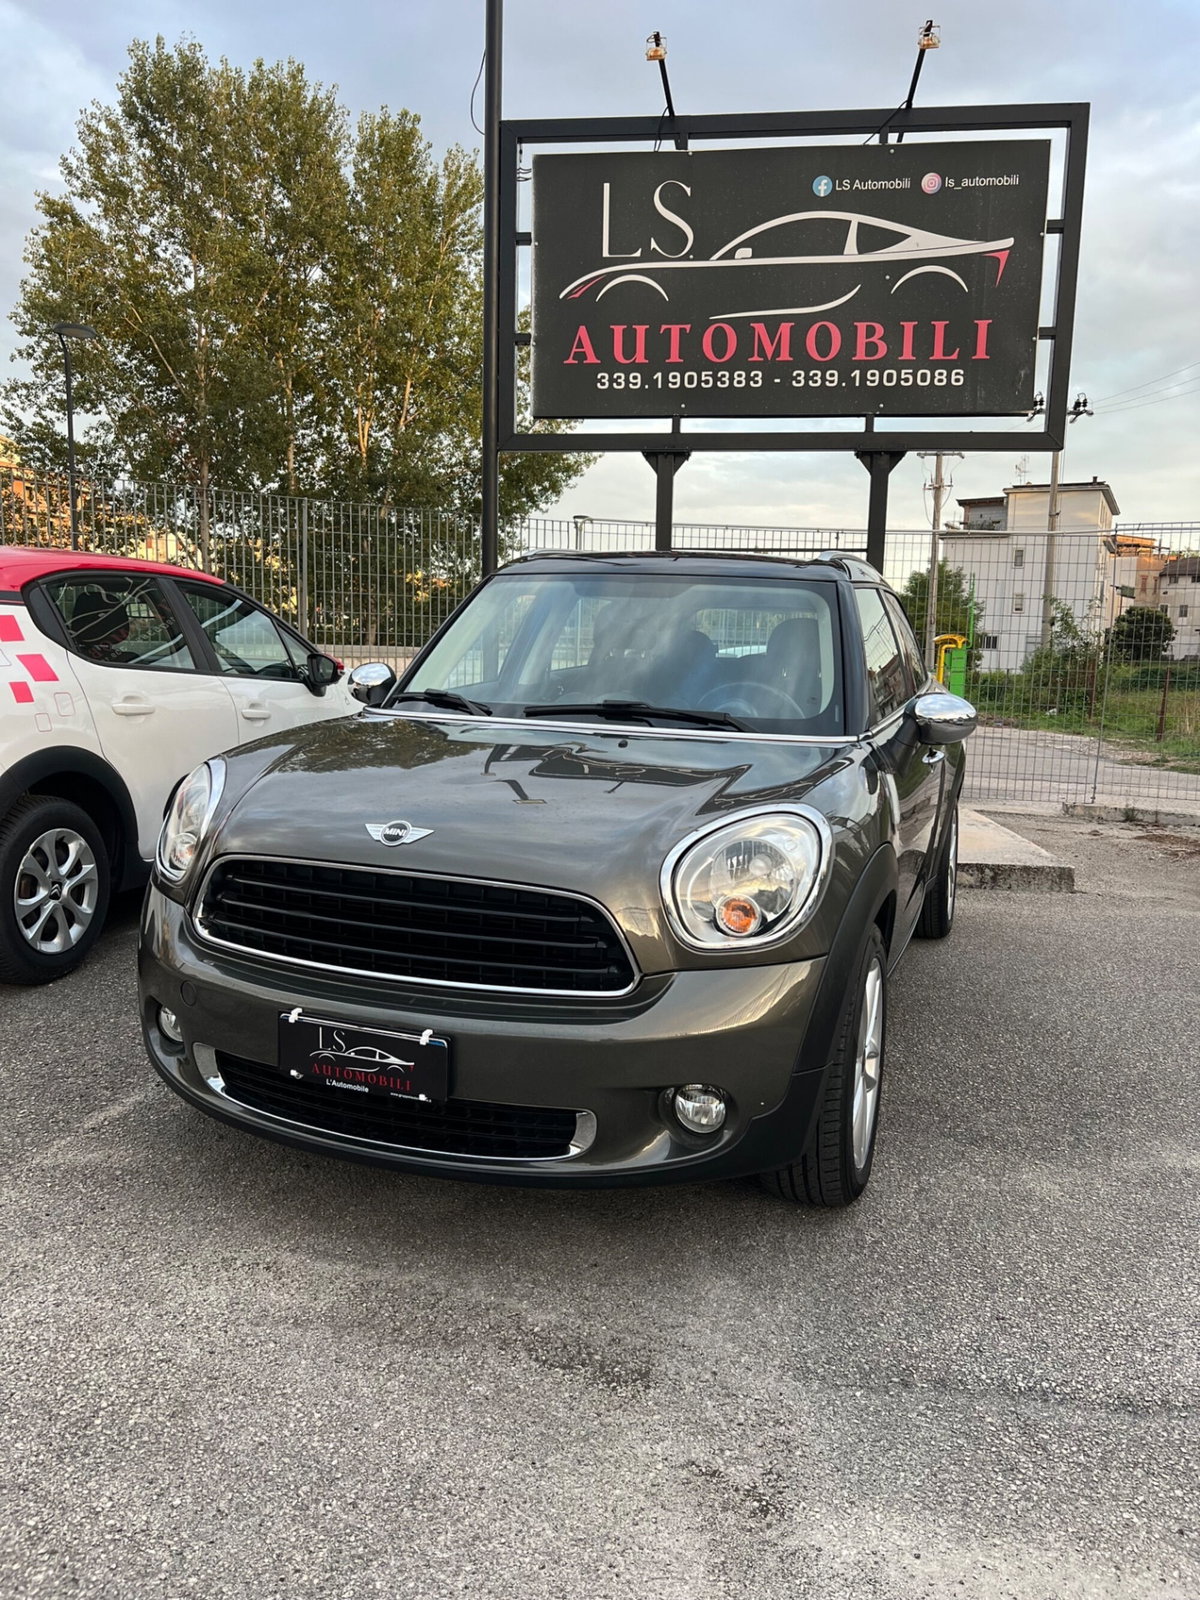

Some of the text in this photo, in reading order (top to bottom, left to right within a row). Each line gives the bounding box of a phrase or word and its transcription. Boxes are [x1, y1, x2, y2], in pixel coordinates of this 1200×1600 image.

[835, 179, 850, 191] LS
[852, 177, 911, 190] Automobili
[945, 174, 1020, 190] ls_automobili
[563, 319, 993, 364] AUTOMOBILI
[596, 370, 763, 389] 339.1905383
[791, 369, 965, 388] 339.1905086
[384, 827, 407, 837] MINI
[319, 1026, 346, 1053] LS
[312, 1063, 412, 1092] AUTOMOBILI
[326, 1078, 369, 1094] L'Automobile
